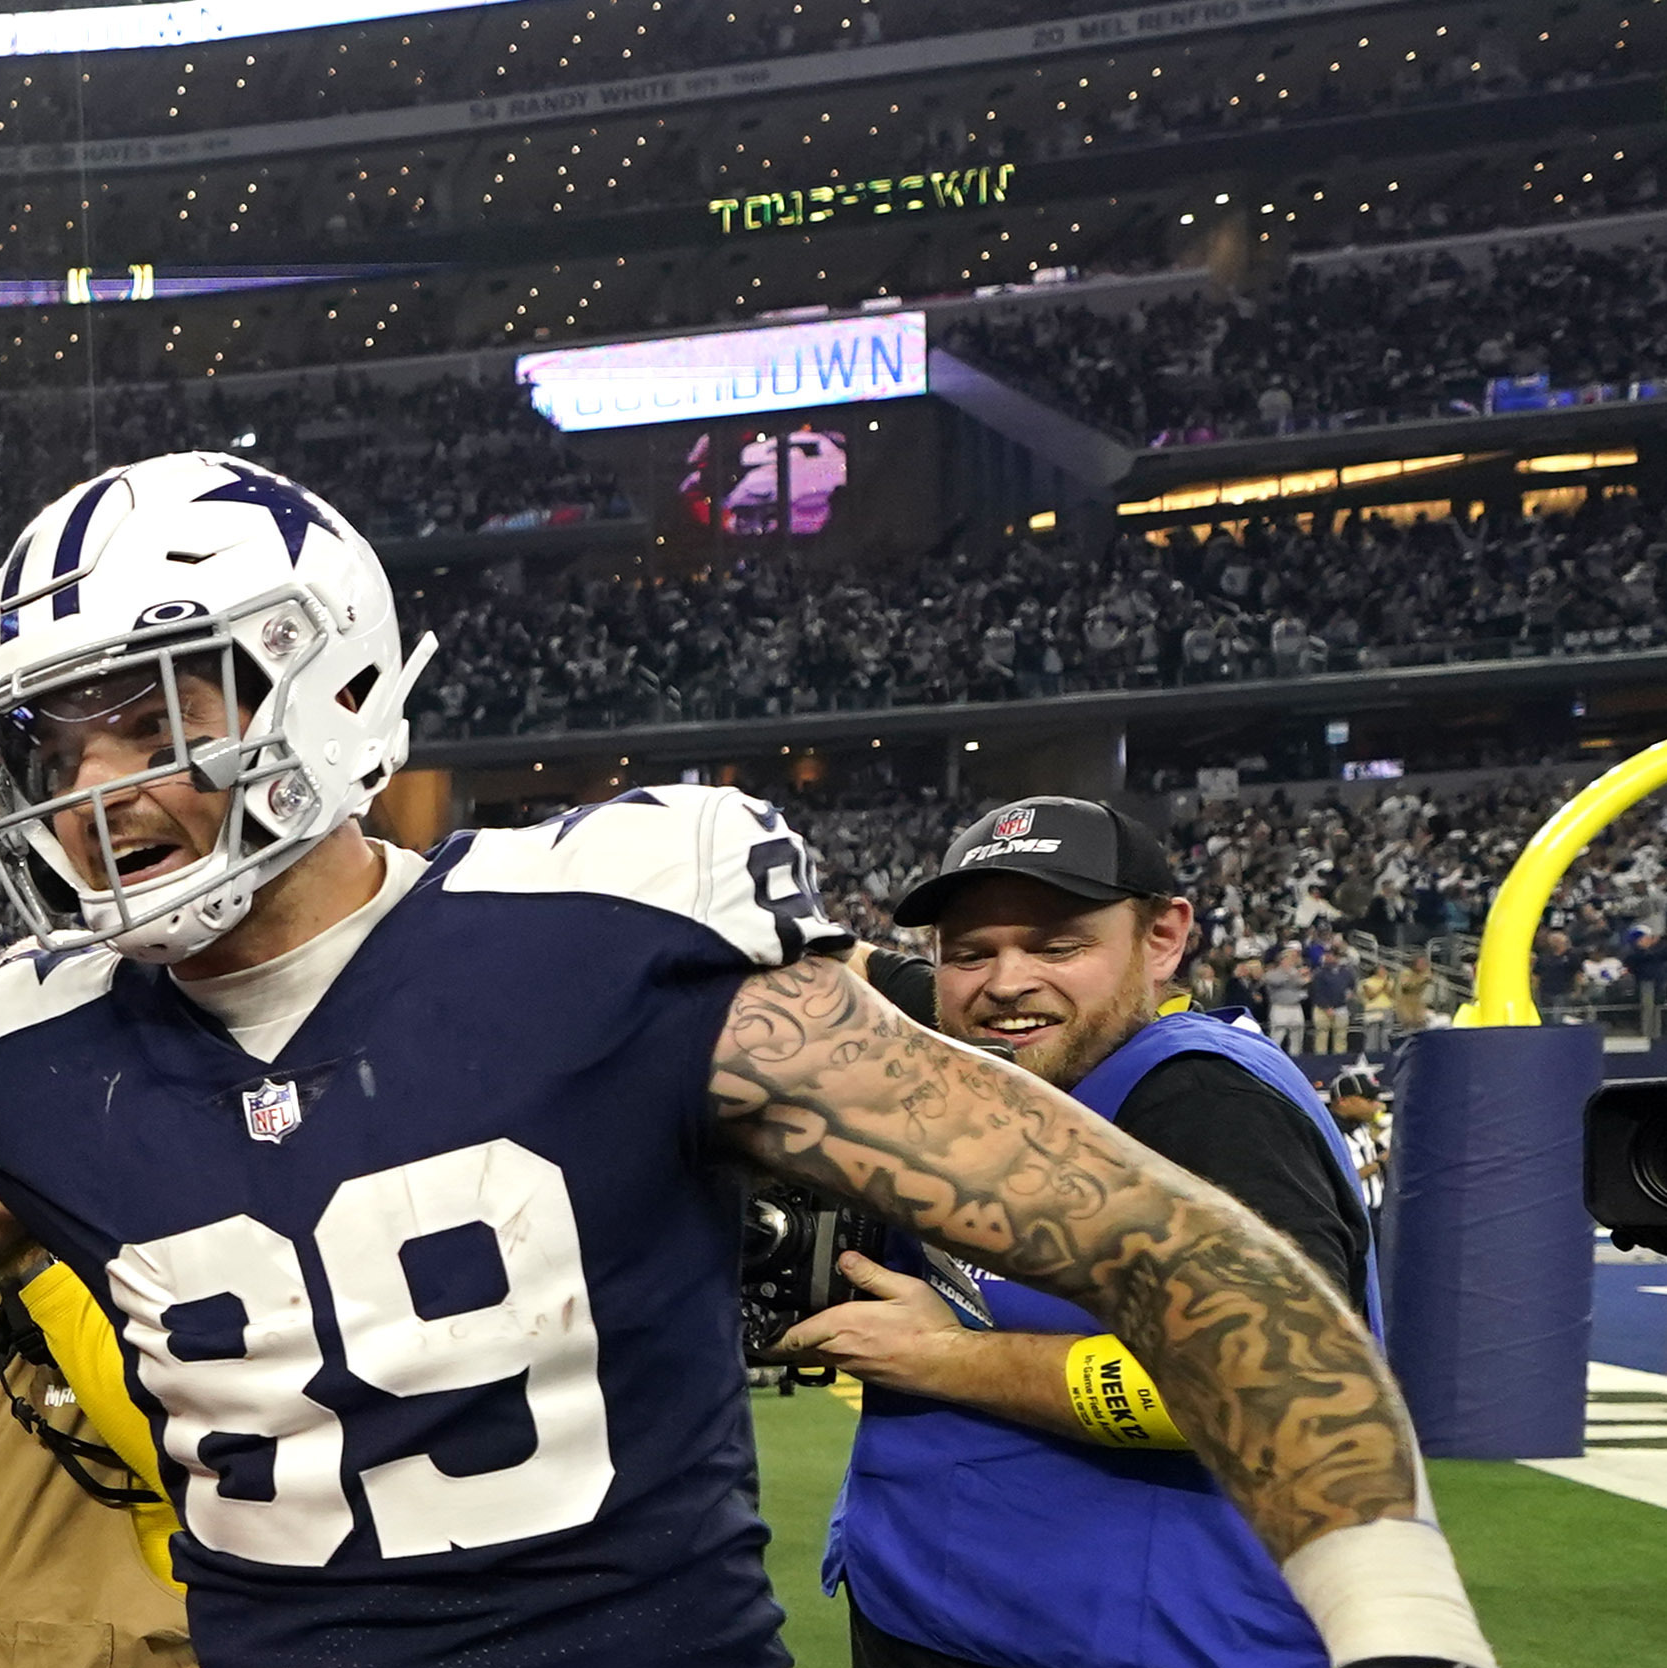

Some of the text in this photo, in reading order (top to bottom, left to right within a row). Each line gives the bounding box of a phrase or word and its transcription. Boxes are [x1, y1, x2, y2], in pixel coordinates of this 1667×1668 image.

[997, 819, 1027, 836] NFL
[958, 839, 1063, 868] FILMS
[252, 1104, 294, 1135] NFL
[105, 1137, 617, 1568] 89
[1083, 1354, 1096, 1395] In-Game
[1100, 1358, 1138, 1427] WEEK
[1120, 1424, 1150, 1442] 12
[1137, 1387, 1156, 1412] DAL
